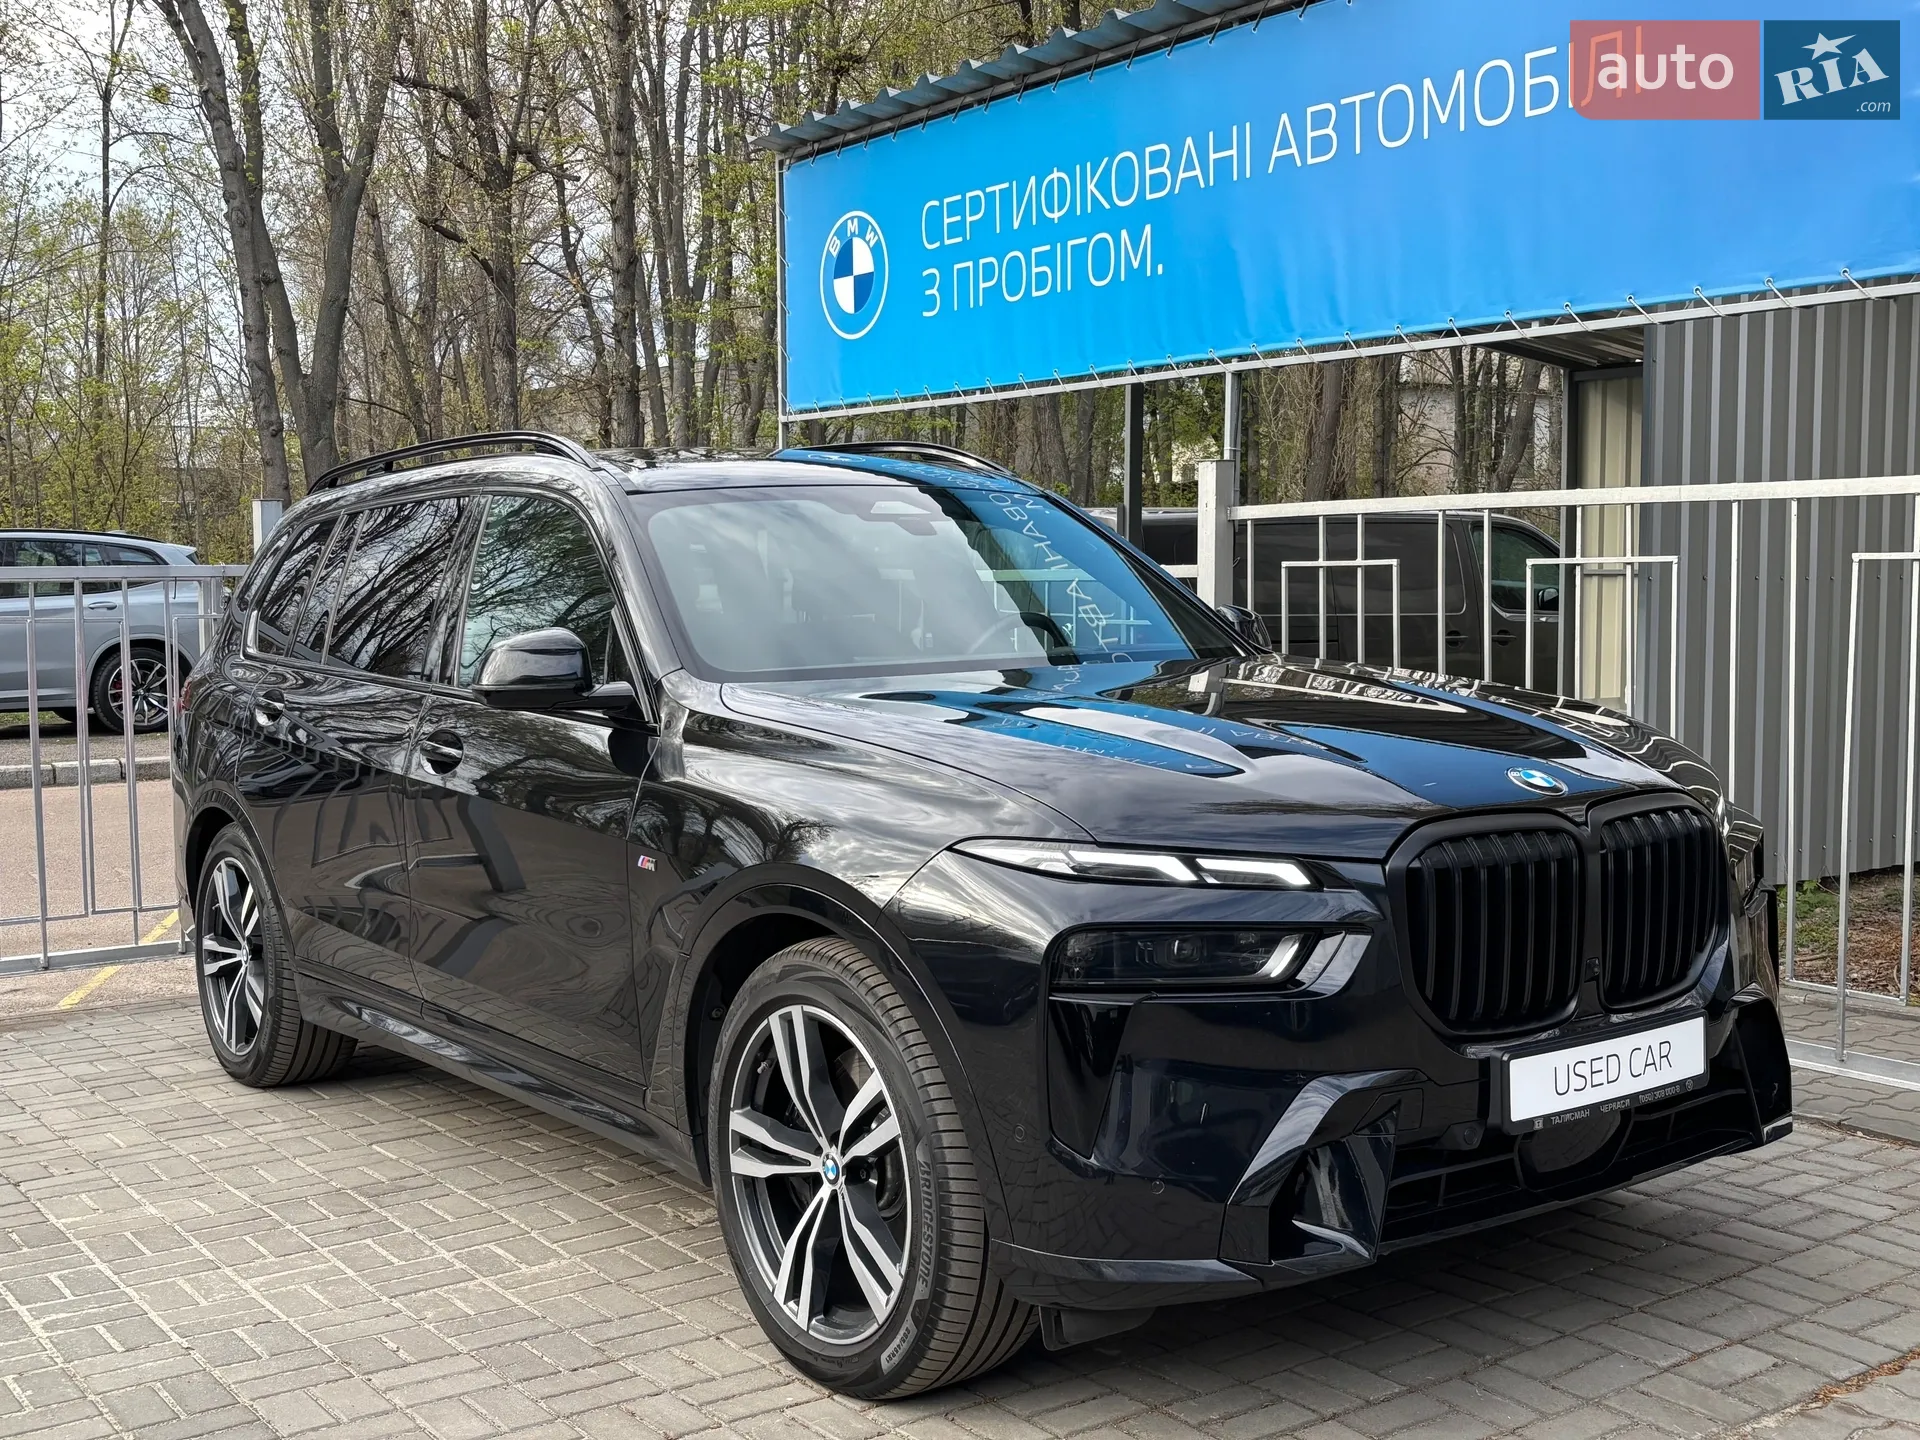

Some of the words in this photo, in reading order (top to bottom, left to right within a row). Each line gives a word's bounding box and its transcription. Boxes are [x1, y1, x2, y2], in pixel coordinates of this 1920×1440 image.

[921, 121, 1252, 251] СЕРТИФІКОВАНІ
[828, 217, 879, 258] BMW
[921, 269, 941, 319] З
[953, 223, 1164, 312] ПРОБІГОМ.
[1554, 1053, 1621, 1097] USED
[1629, 1040, 1673, 1080] CAR
[1550, 1108, 1590, 1125] ТАЛИСМАН
[917, 1160, 935, 1288] BRIDGESTONE
